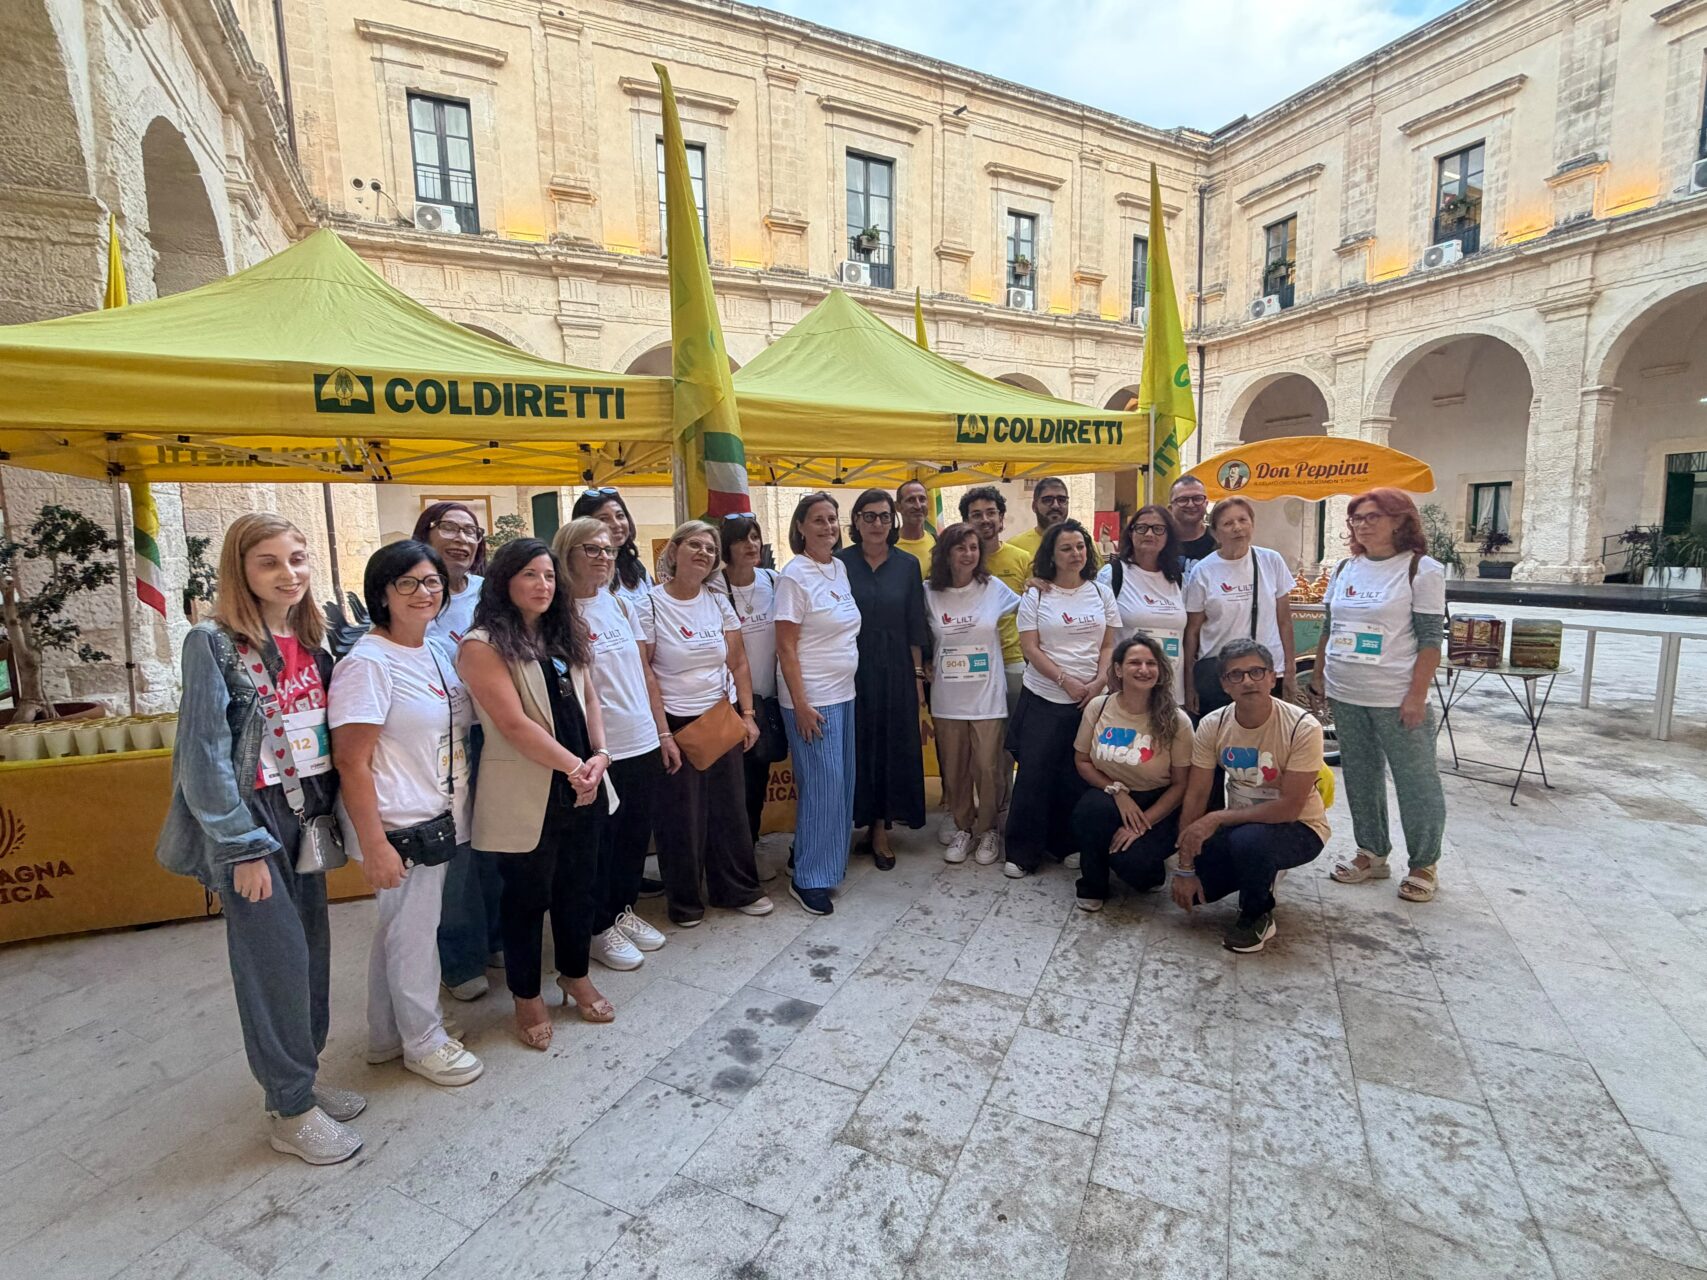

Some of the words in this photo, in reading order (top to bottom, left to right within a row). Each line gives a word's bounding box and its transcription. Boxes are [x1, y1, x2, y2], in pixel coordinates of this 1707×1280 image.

[384, 377, 625, 420] COLDIRETTI
[993, 416, 1123, 445] COLDIRETTI
[1255, 462, 1290, 479] Don
[1294, 460, 1369, 480] Peppinu
[1360, 591, 1382, 599] LILT
[751, 613, 767, 623] LILT
[956, 615, 973, 624] LILT
[1078, 614, 1095, 624] LILT
[603, 629, 622, 640] LILT
[699, 630, 717, 639] LILT
[946, 660, 966, 668] 9041
[441, 748, 464, 767] 940
[764, 786, 798, 803] ICA
